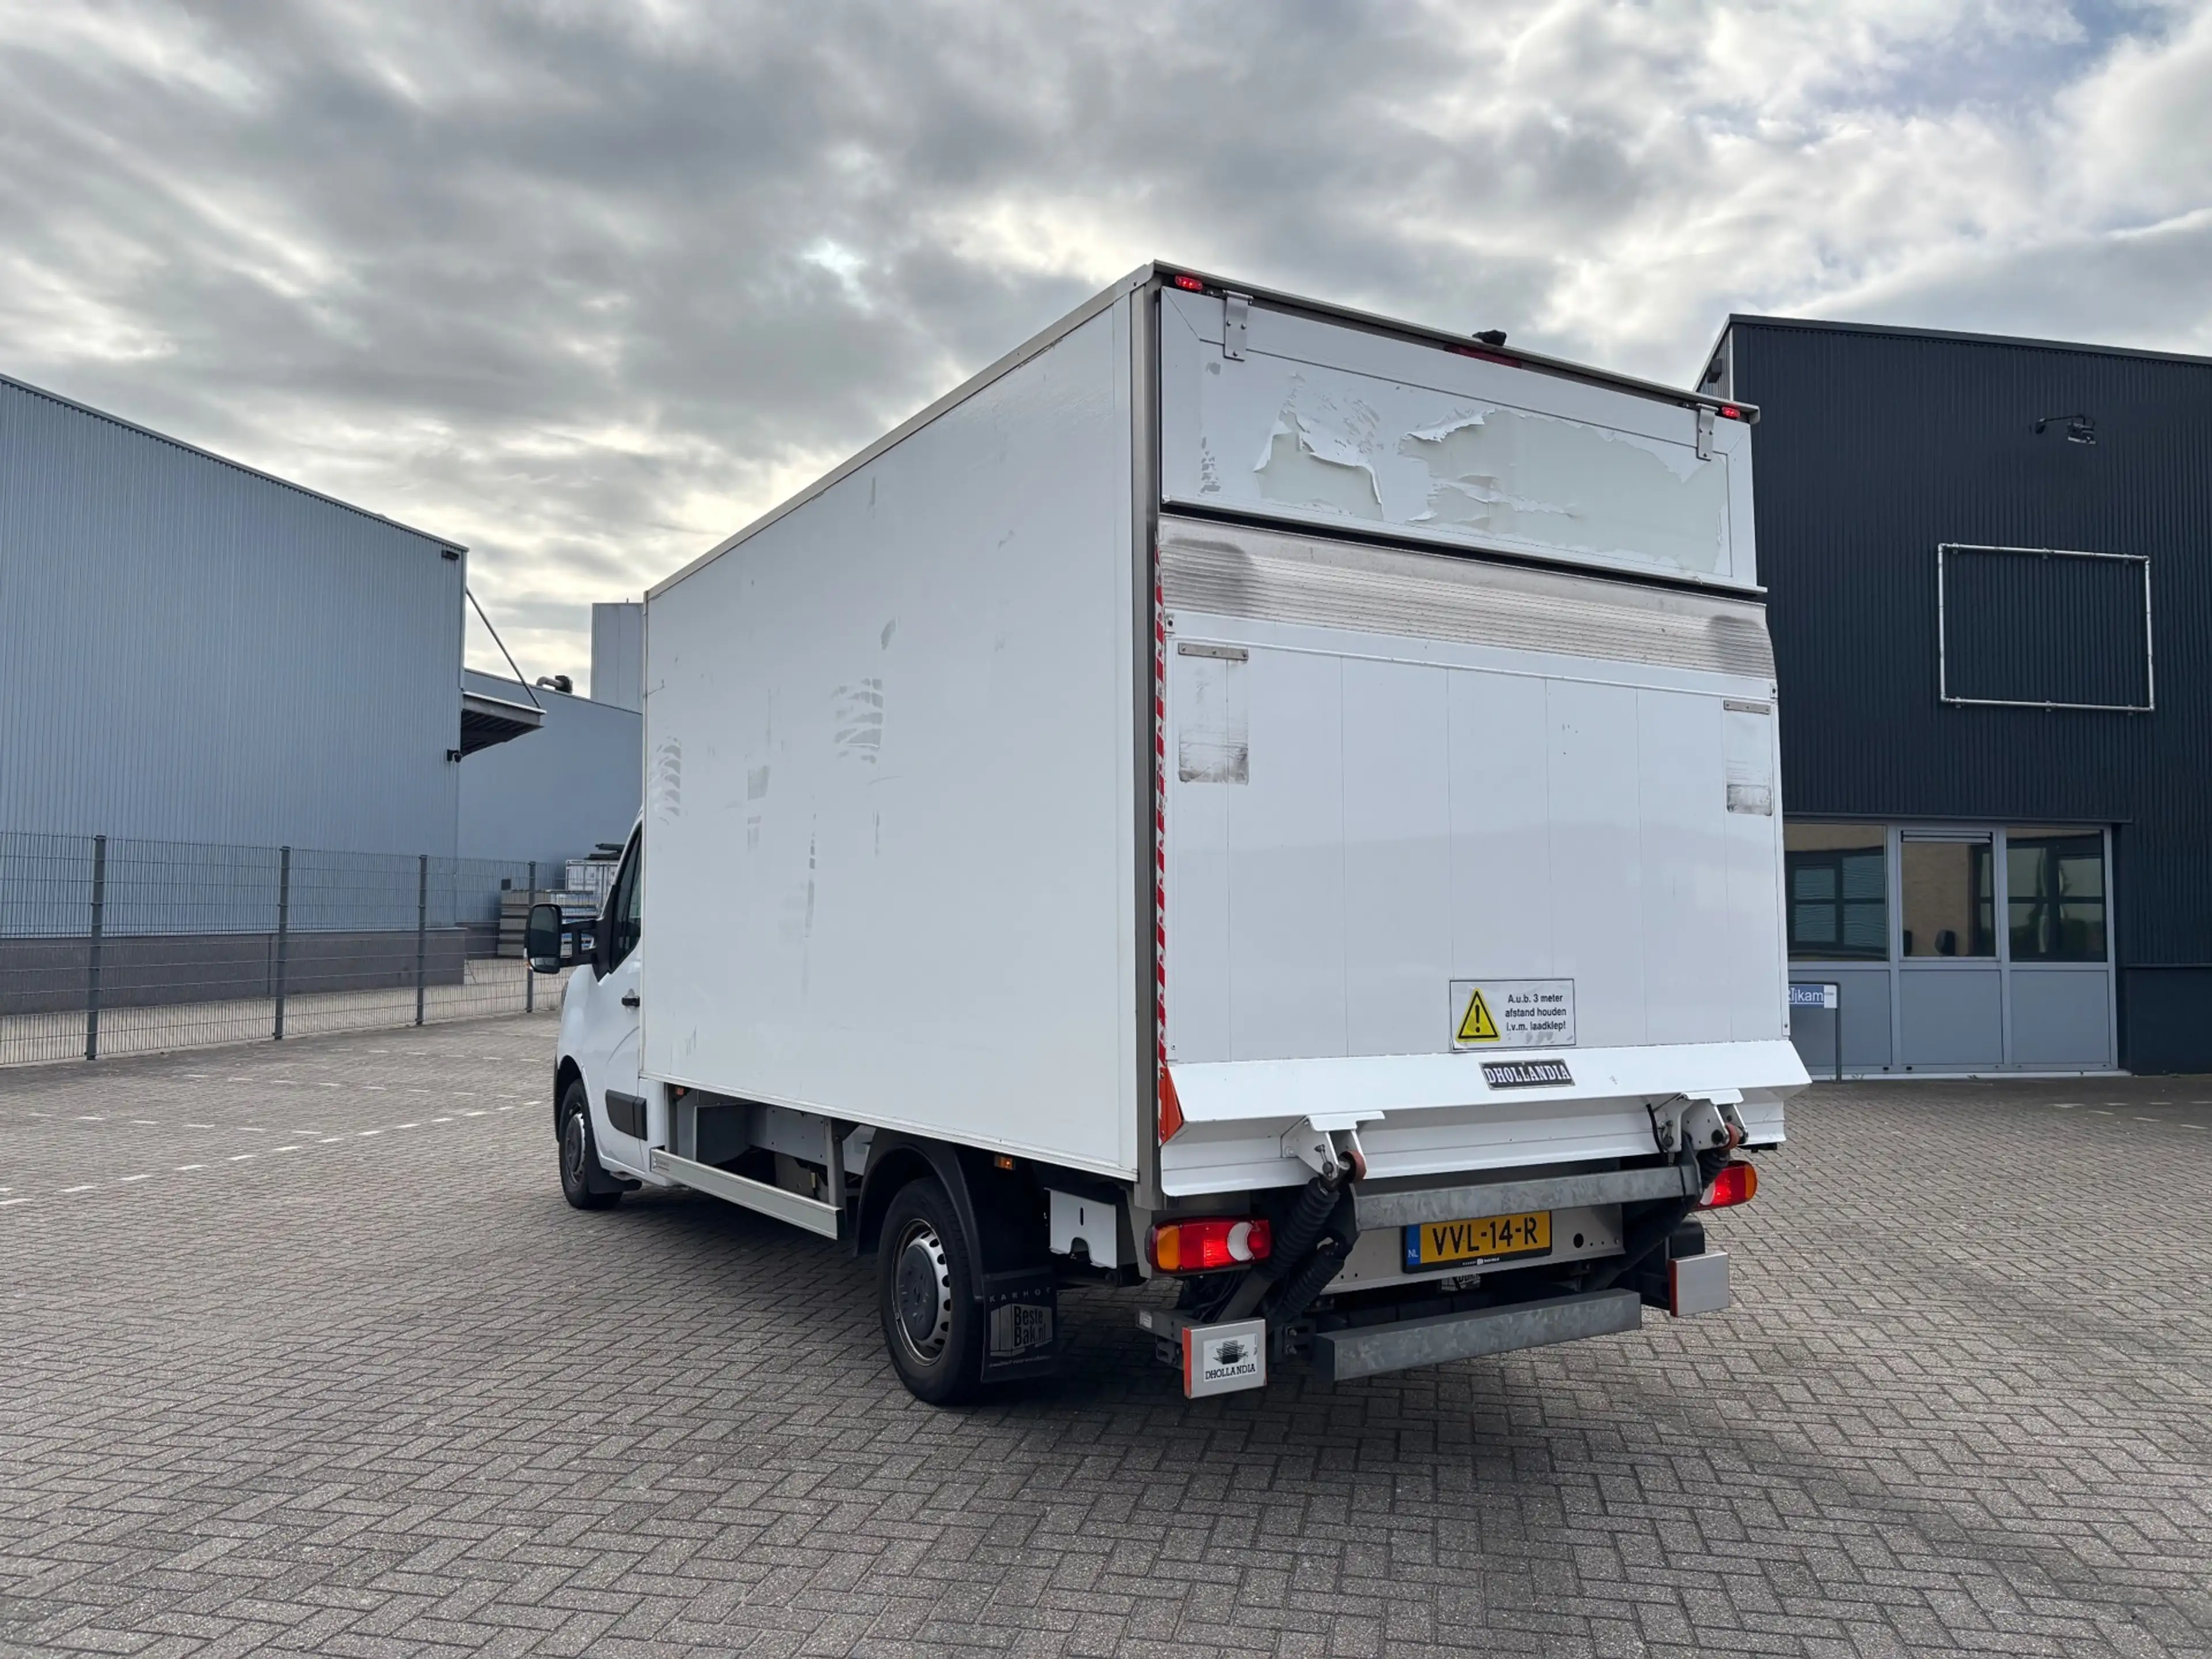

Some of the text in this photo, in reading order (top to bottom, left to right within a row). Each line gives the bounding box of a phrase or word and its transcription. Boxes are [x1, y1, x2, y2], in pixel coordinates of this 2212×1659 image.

[1508, 993, 1563, 1003] A.u.b. 3 meter
[1505, 1007, 1567, 1017] afstand houden
[1530, 1020, 1566, 1032] laadklep!
[1483, 1064, 1571, 1084] DHOLLANDIA
[1407, 1217, 1538, 1258] NL VVL-14-R
[1014, 1305, 1043, 1325] Beste
[1205, 1363, 1256, 1380] DHOLLANDIA
